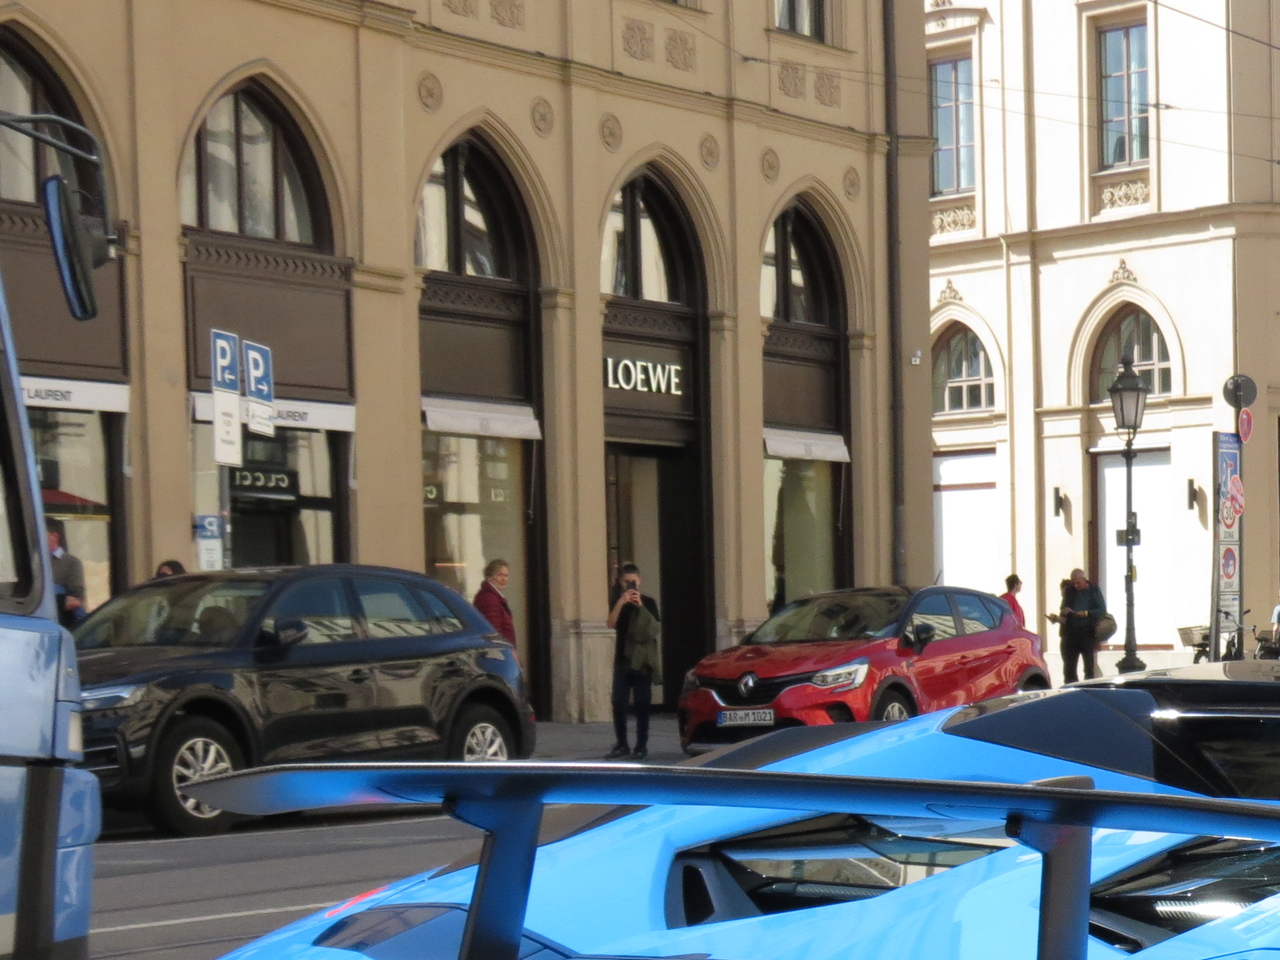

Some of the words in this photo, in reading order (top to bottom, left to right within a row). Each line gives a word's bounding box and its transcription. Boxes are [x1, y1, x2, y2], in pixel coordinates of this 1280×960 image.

[216, 338, 232, 382] P
[248, 350, 265, 392] P
[606, 357, 682, 395] LOEWE
[27, 388, 72, 402] LAURENT
[1223, 531, 1234, 540] ZONE
[723, 712, 738, 722] BAR
[744, 711, 750, 722] M
[752, 711, 773, 722] 1021
